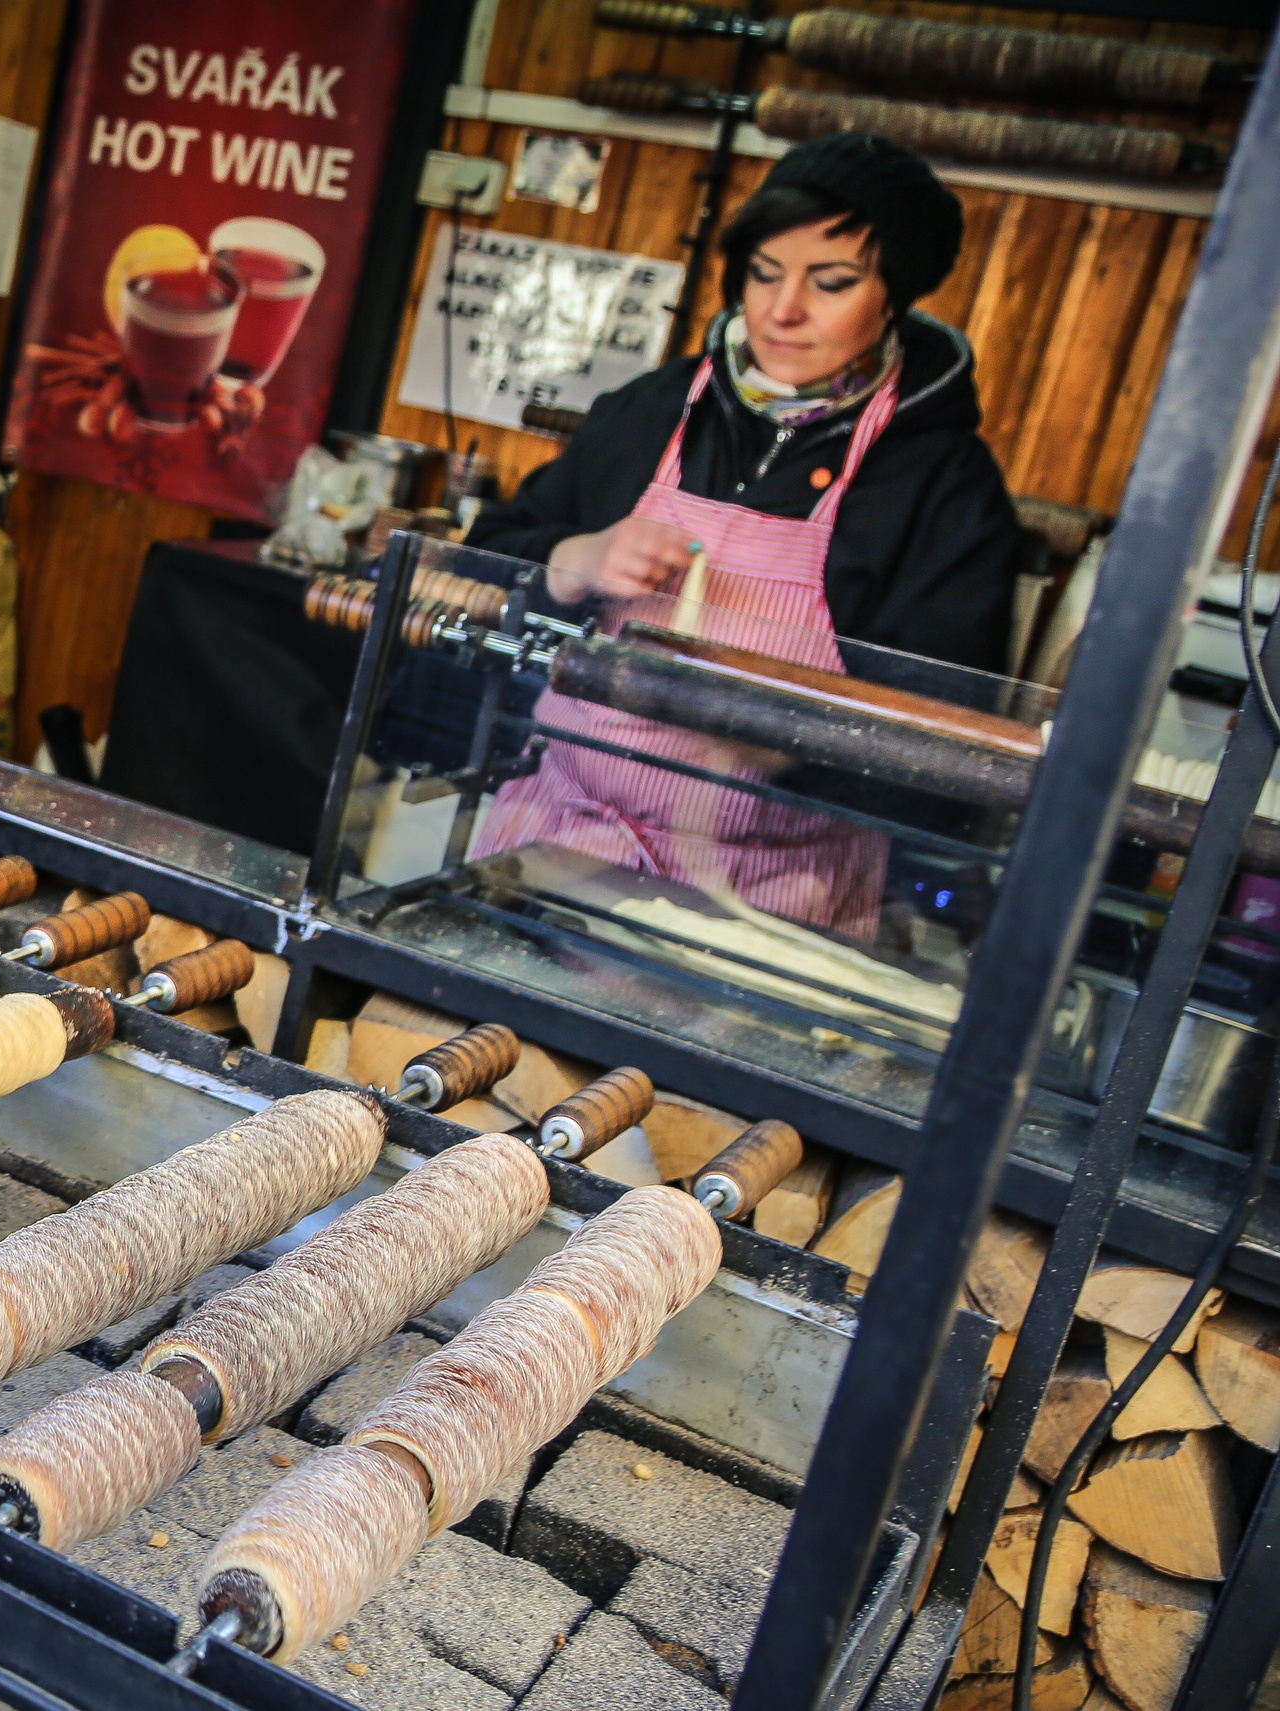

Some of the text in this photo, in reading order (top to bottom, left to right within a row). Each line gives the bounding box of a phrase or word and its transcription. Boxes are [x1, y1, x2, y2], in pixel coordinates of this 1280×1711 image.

[124, 44, 344, 120] SVAŘÁK
[88, 115, 354, 202] HOT WINE
